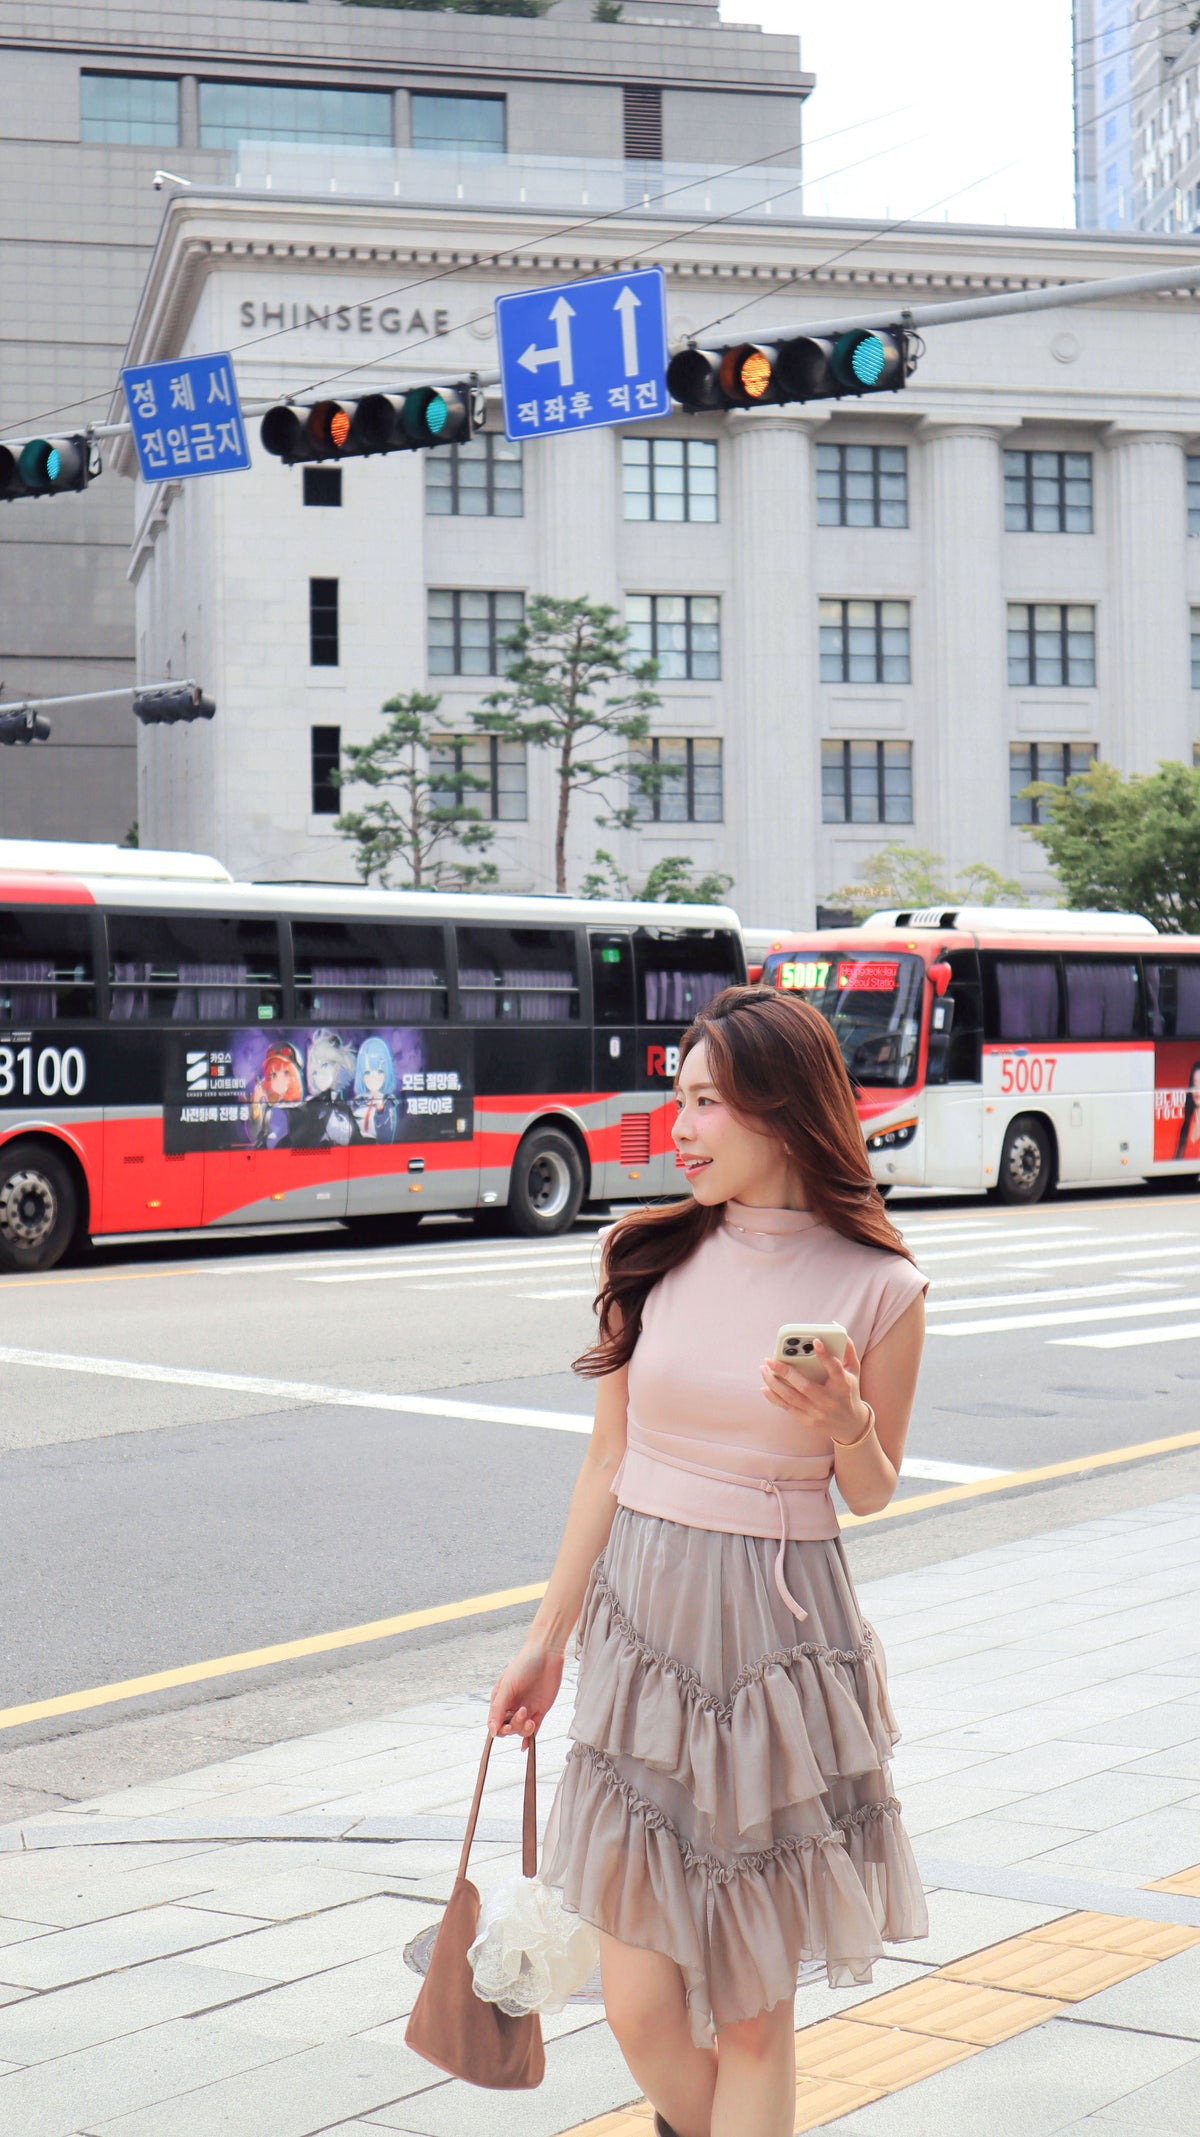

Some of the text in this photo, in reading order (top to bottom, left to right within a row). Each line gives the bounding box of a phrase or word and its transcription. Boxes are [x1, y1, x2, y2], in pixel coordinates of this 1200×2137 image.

[240, 301, 450, 337] SHINSEGAE
[517, 380, 658, 428] 직좌후 직진
[141, 417, 241, 468] 진입금지
[781, 962, 830, 989] 5007
[848, 976, 898, 987] Seoul Statio
[0, 1046, 85, 1096] 8100
[210, 1053, 232, 1064] 카오스
[1001, 1058, 1057, 1093] 5007
[402, 1072, 461, 1091] 모든 절망을,
